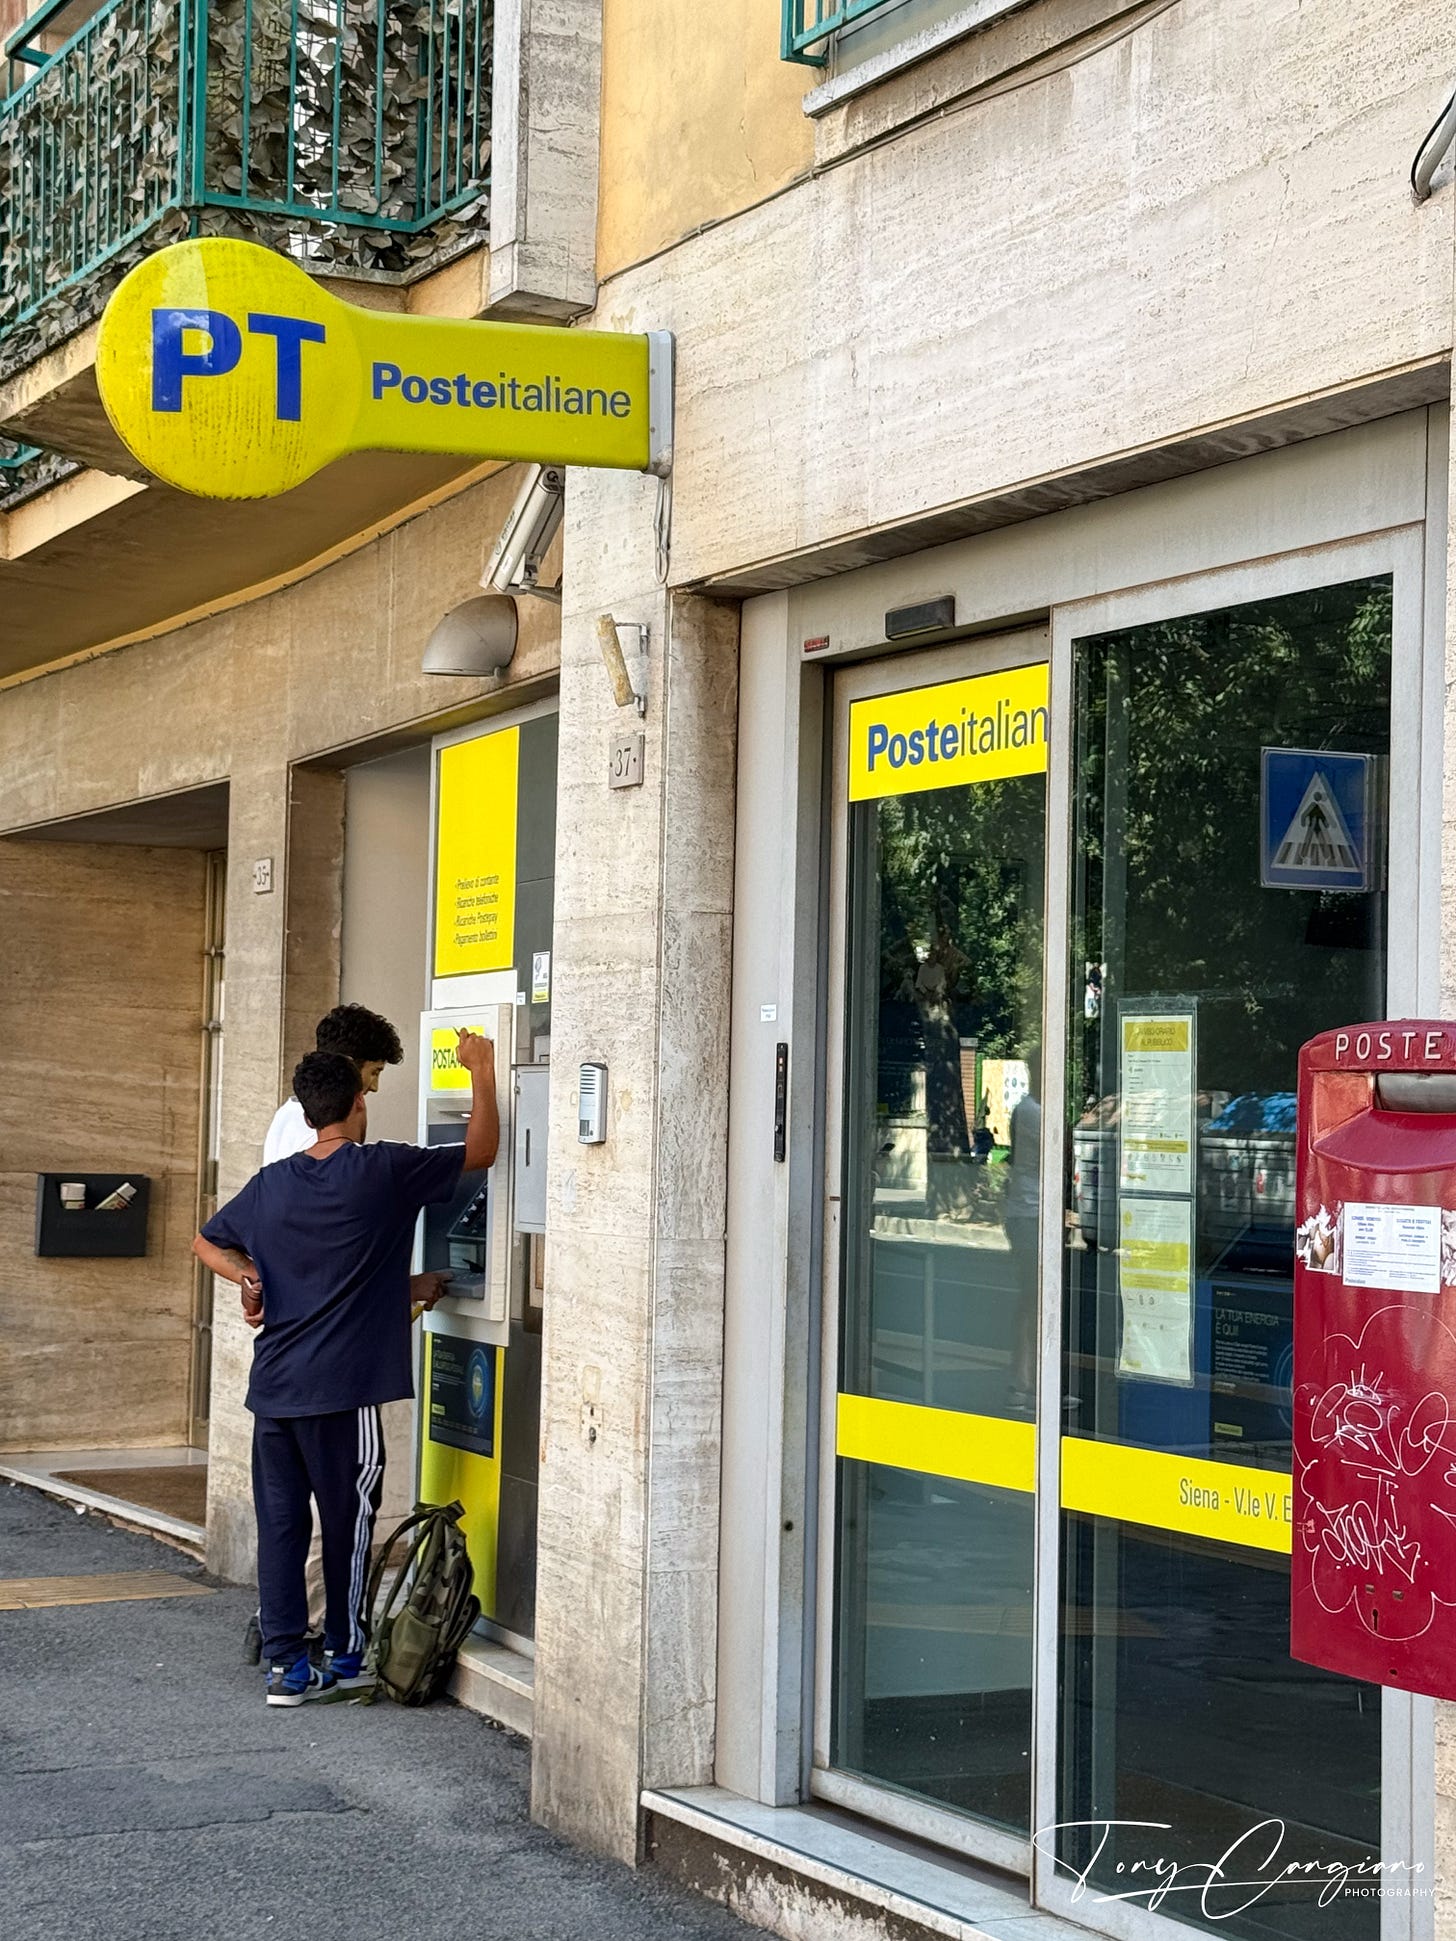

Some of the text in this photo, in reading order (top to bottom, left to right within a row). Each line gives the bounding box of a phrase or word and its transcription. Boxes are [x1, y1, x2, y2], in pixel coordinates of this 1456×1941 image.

[151, 308, 326, 422] PT
[371, 362, 632, 419] Posteitaliane
[868, 698, 1048, 772] Posteitalian
[615, 747, 632, 777] 37
[432, 1048, 464, 1070] POSTA
[1335, 1031, 1443, 1060] POSTE
[1180, 1478, 1219, 1511] Siena
[1234, 1486, 1260, 1518] V.le
[1265, 1491, 1278, 1521] V.
